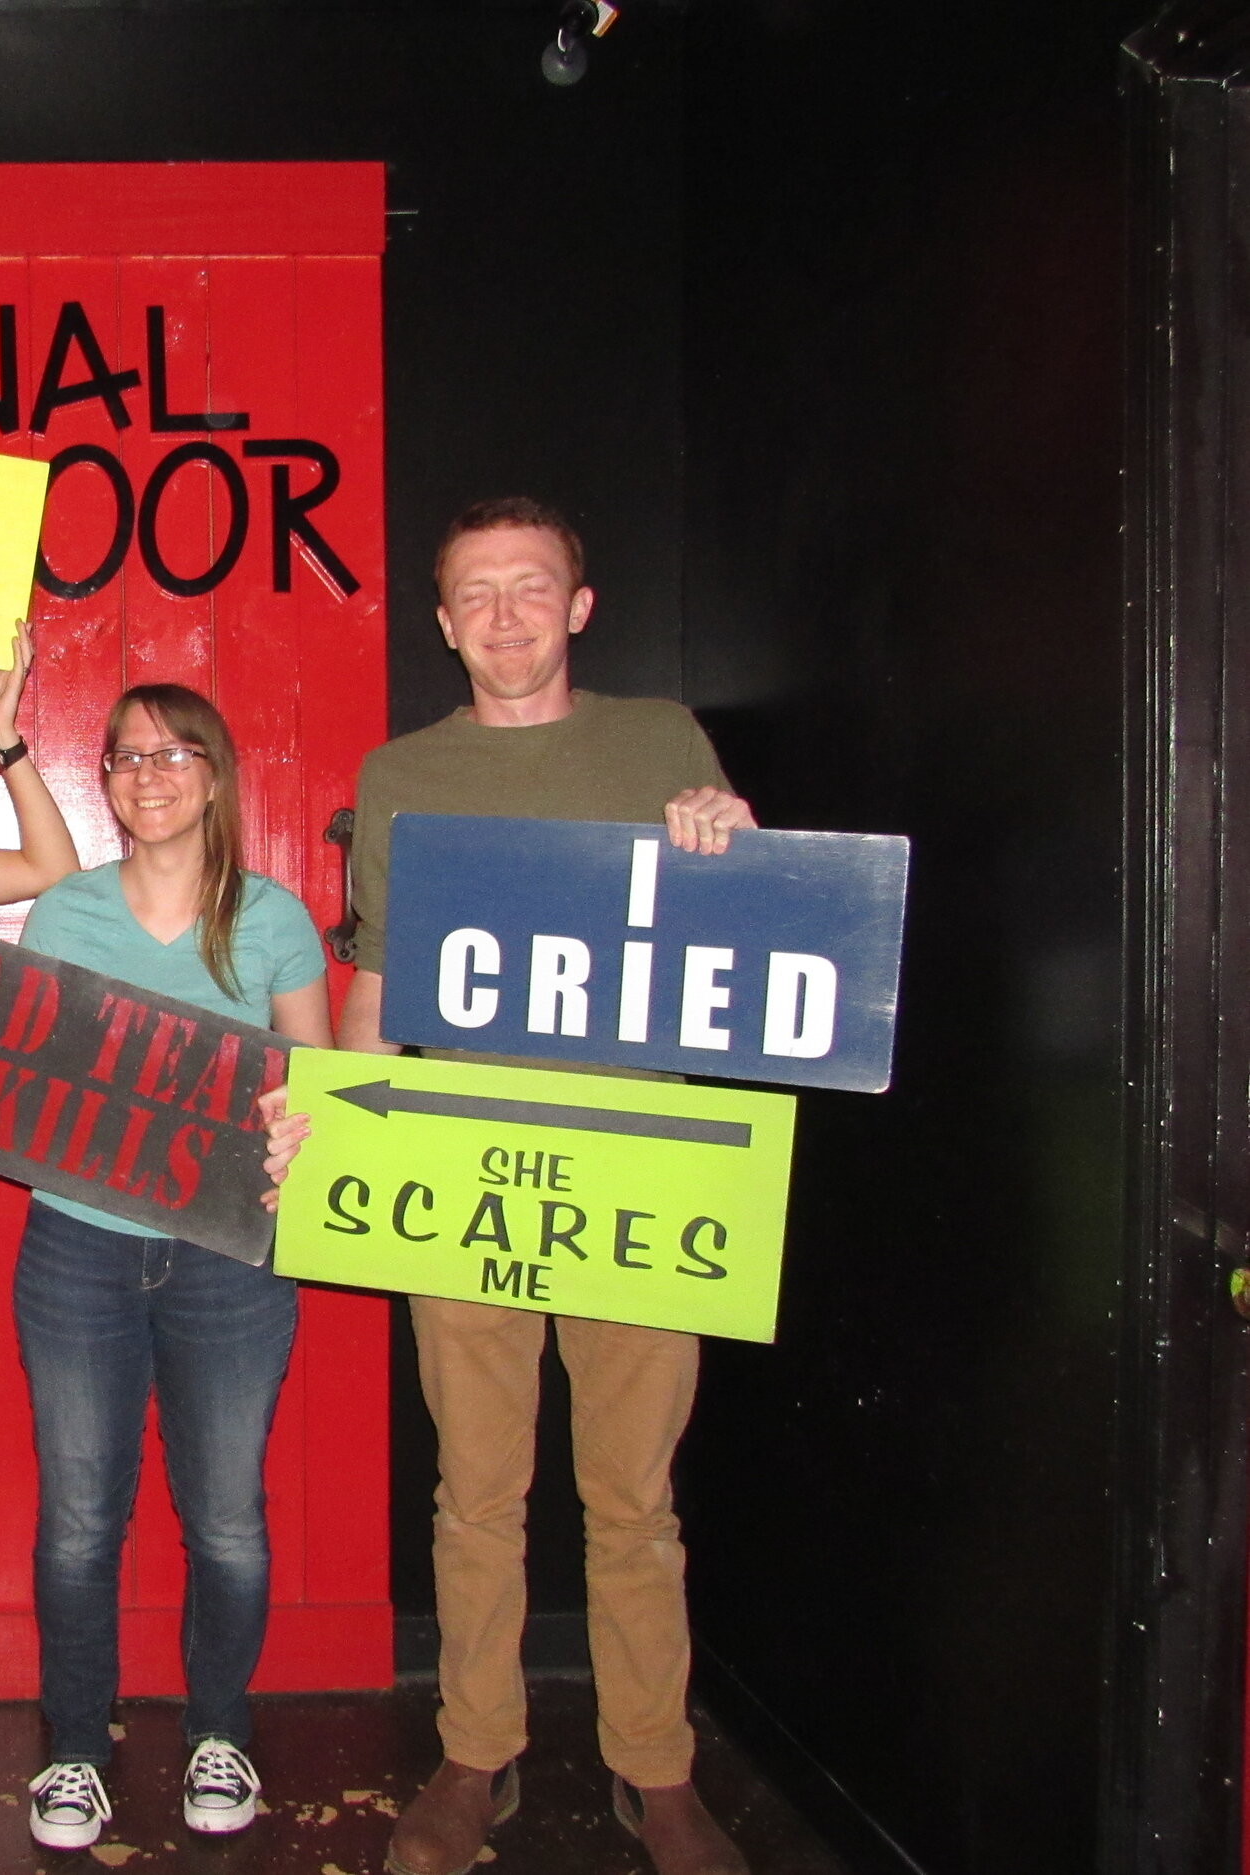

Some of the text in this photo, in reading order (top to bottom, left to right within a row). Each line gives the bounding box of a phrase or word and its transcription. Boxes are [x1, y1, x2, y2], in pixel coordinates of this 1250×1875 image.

[33, 438, 360, 599] OOR
[628, 839, 658, 927] I
[439, 929, 836, 1058] CRIED
[479, 1147, 573, 1192] SHE
[324, 1175, 727, 1280] SCARES
[481, 1258, 552, 1301] ME
